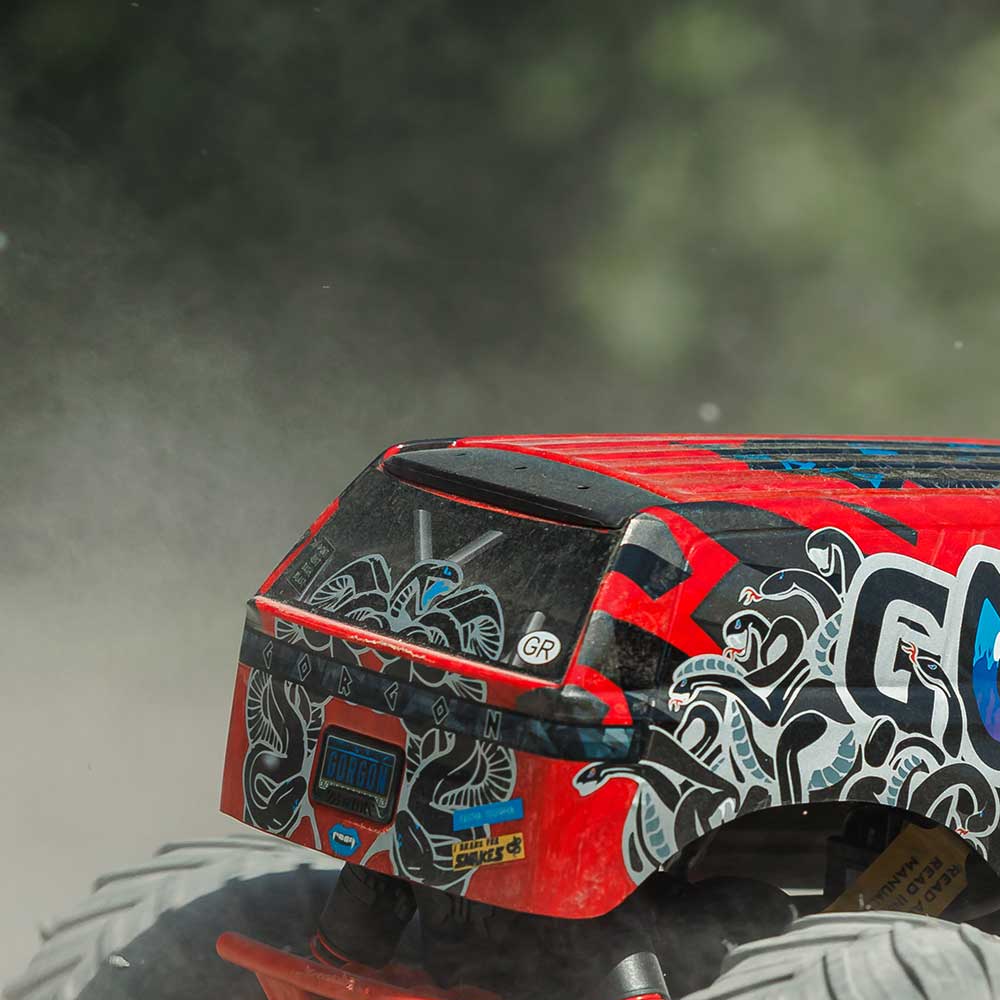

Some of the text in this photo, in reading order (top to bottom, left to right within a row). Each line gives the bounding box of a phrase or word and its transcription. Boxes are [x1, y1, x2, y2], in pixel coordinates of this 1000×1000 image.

[522, 635, 555, 660] GR
[326, 750, 388, 795] GORGON
[906, 855, 944, 896] READ
[924, 863, 961, 903] READ
